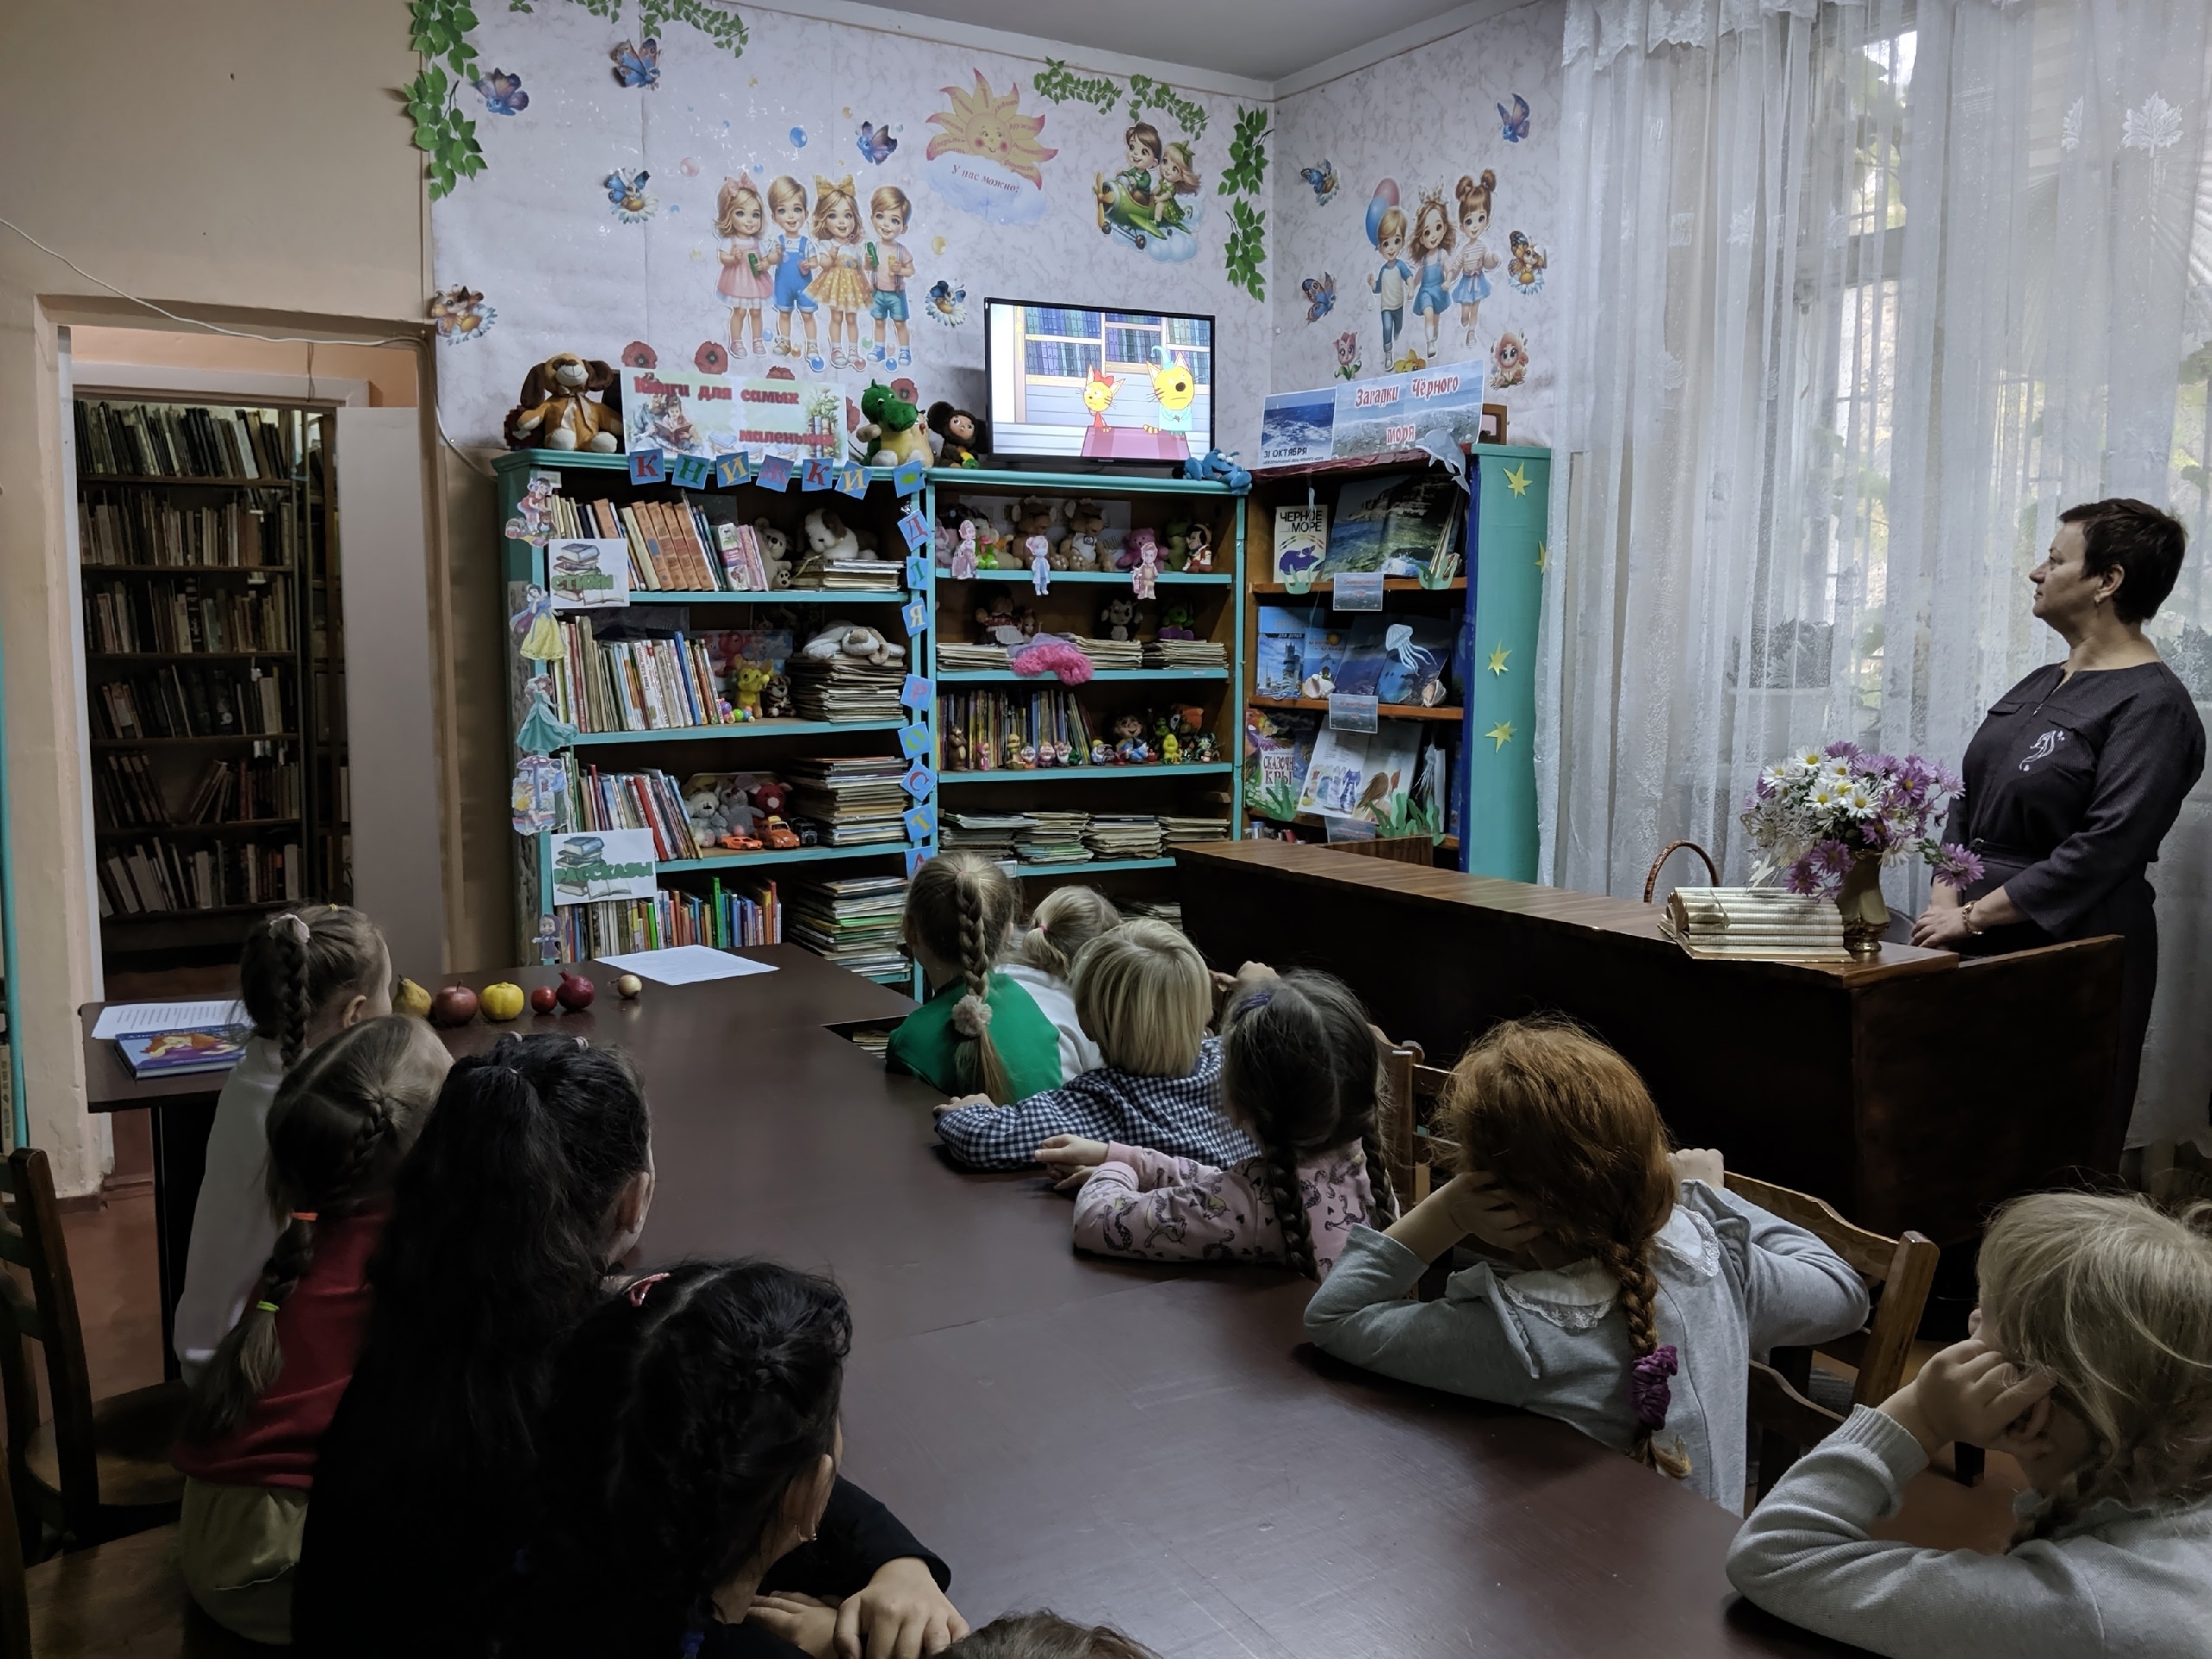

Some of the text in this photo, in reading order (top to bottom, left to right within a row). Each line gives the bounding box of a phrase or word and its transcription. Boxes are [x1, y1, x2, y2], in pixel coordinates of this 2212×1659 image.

[951, 164, 961, 175] У
[962, 169, 980, 181] нас
[633, 376, 800, 404] Книги для самых
[1355, 376, 1459, 408] Загадки Чёрного
[739, 429, 835, 446] маленьких
[1386, 425, 1415, 446] моря
[1272, 447, 1307, 458] ОКТЯБРЯ
[636, 453, 866, 493] КНИЖКИ
[1280, 510, 1324, 522] ЧЕРНОЕ
[1291, 522, 1322, 532] МОРЕ
[551, 575, 614, 592] СТИХИ
[1264, 756, 1294, 770] СКАЗОЧН
[1265, 771, 1294, 785] КРЫ
[554, 862, 654, 884] РАССКАЗЫ
